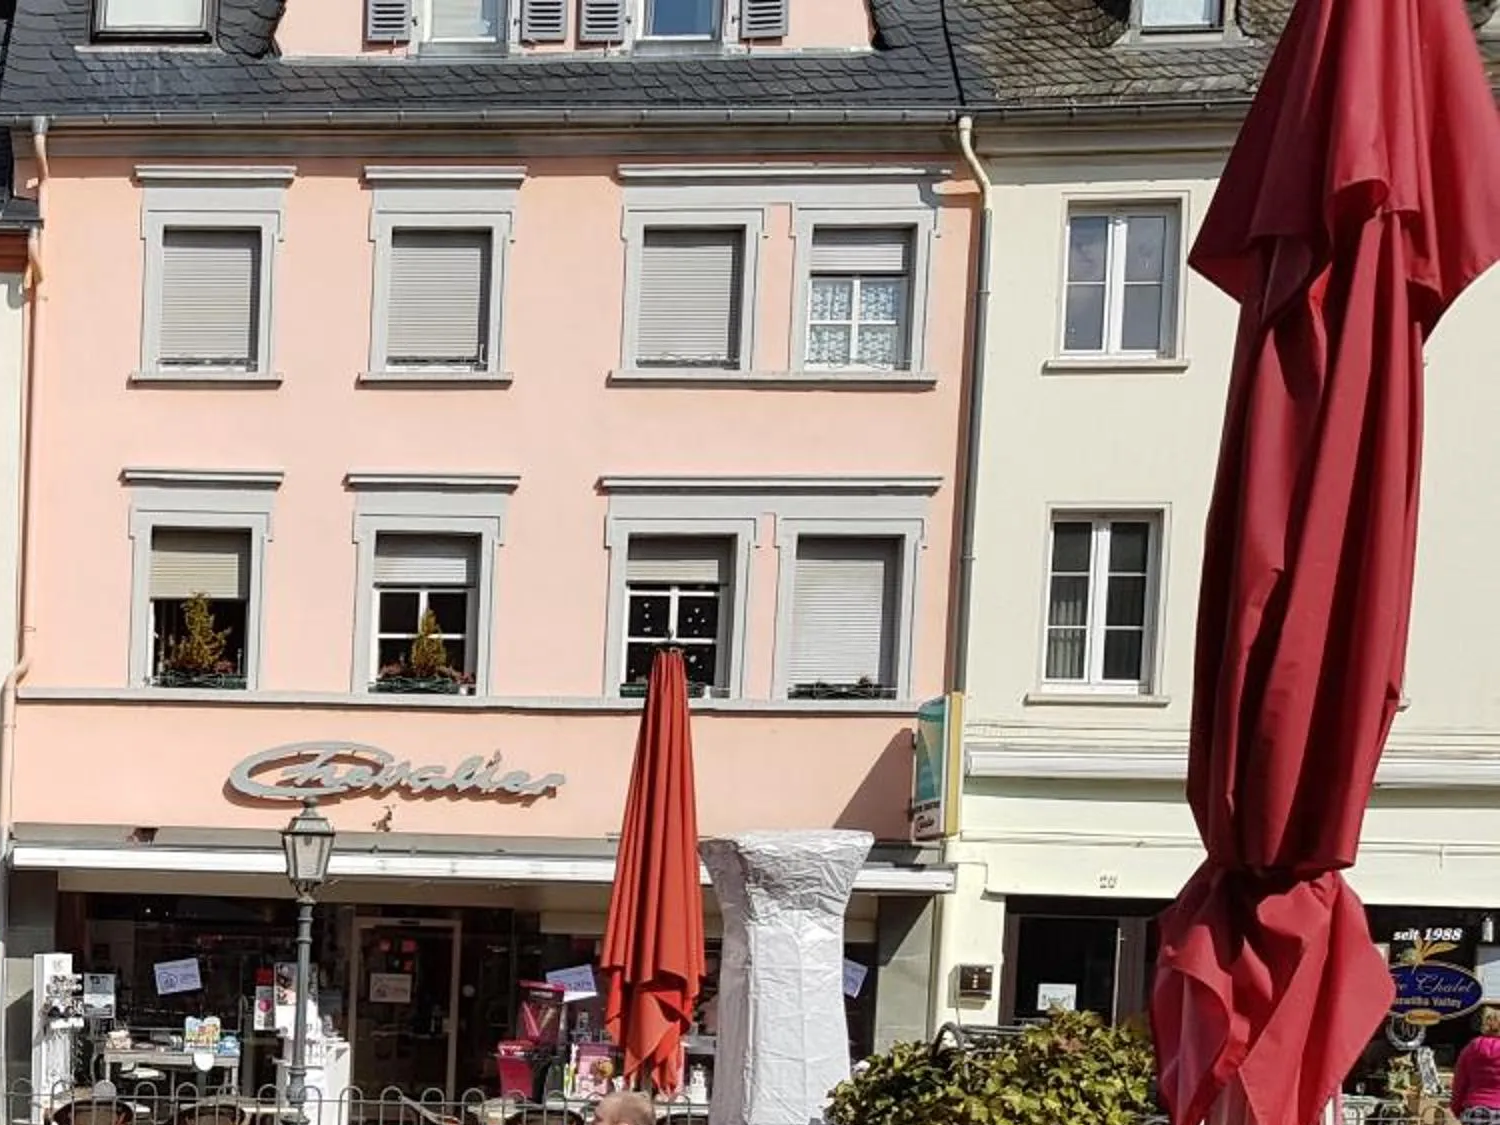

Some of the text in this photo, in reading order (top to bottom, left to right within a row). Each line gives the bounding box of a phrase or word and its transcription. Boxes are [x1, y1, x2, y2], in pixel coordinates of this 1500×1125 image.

[228, 740, 566, 799] Chevalier
[1393, 927, 1463, 941] seit 1988
